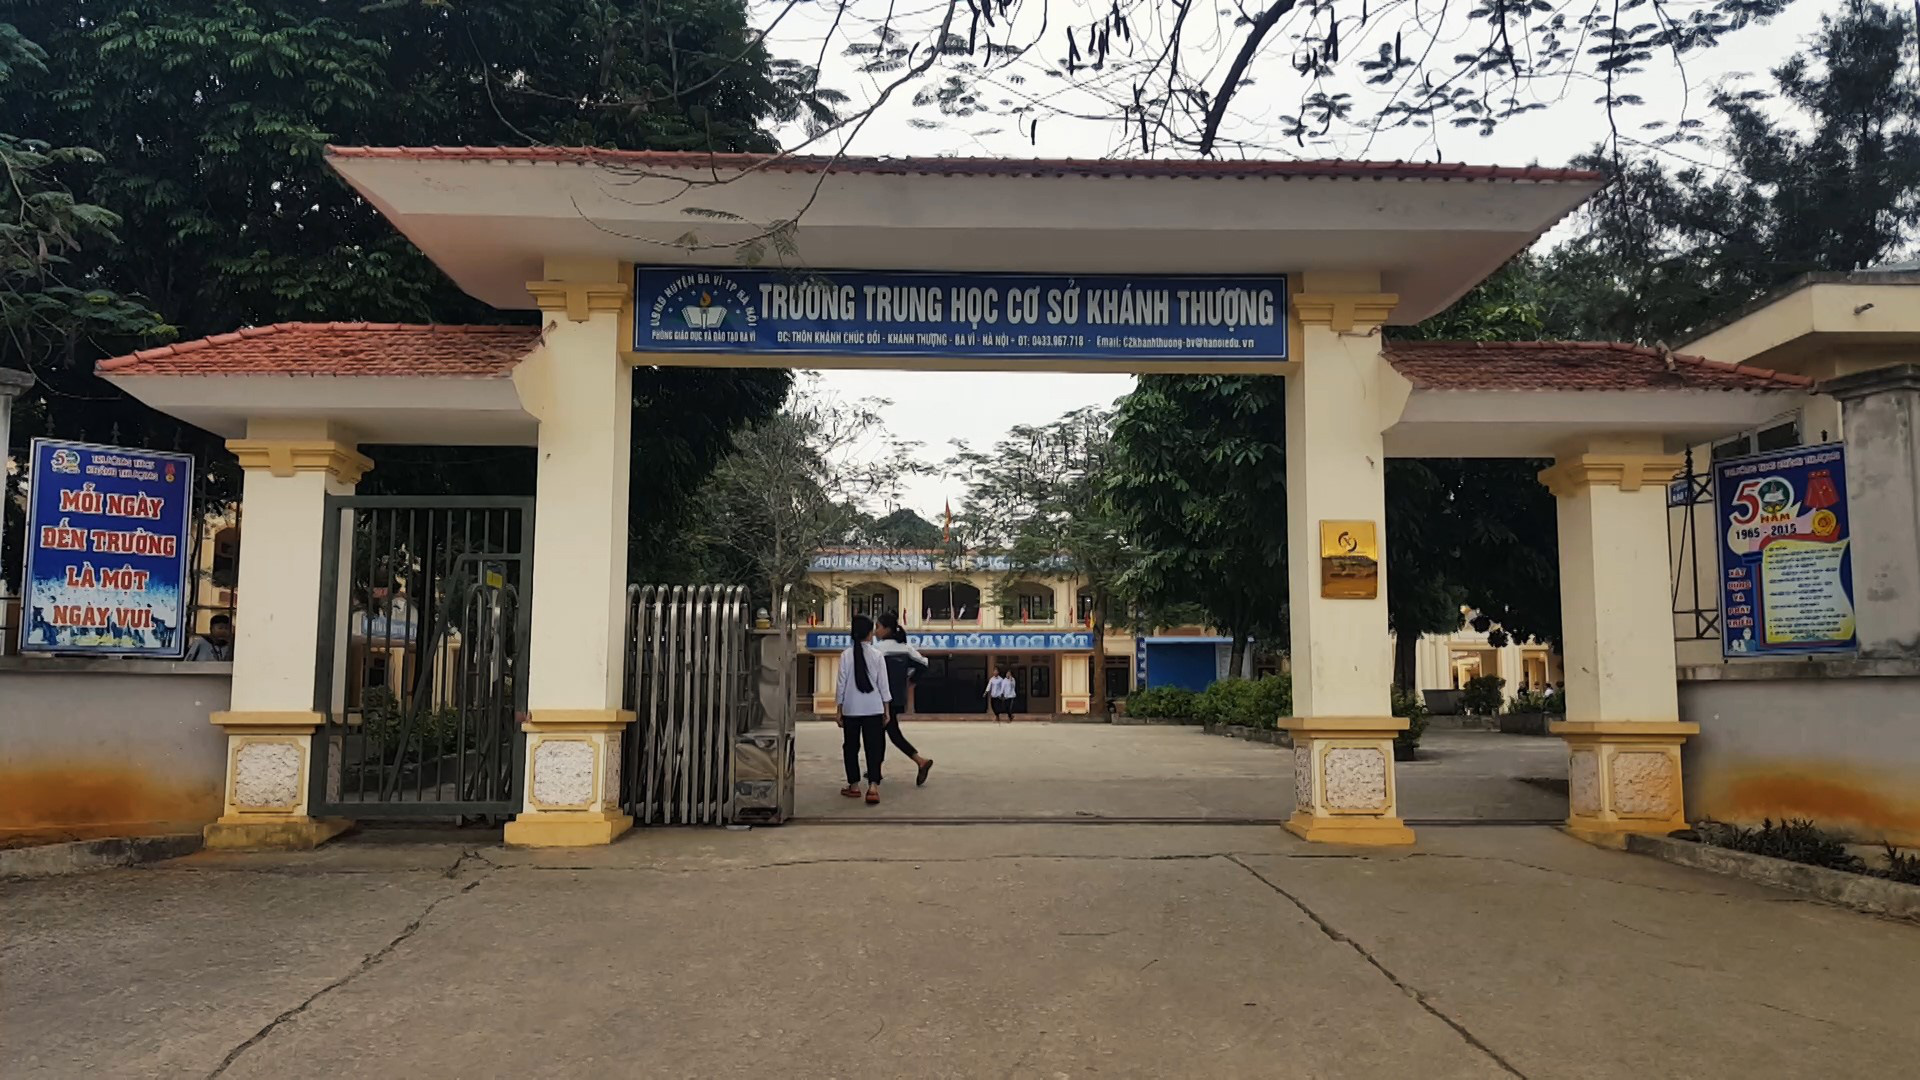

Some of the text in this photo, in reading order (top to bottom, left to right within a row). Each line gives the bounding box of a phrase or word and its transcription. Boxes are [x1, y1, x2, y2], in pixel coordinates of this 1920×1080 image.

[759, 278, 1274, 332] TRƯỜNG TRUNG HỌC CƠ SỞ KHÁNH THƯỢNG
[792, 330, 813, 343] THÔN
[814, 330, 841, 344] KHÁNH
[844, 330, 864, 344] CHÚC
[887, 331, 914, 344] KHÁNH
[916, 332, 947, 347] THƯỢNG
[954, 334, 965, 346] BA
[967, 332, 975, 346] VÌ
[982, 332, 993, 346] HÀ
[995, 332, 1009, 348] NỘI
[1096, 335, 1121, 348] Email:
[60, 483, 164, 519] MỖI NGÀY
[41, 518, 176, 557] ĐẾN TRƯỜNG
[1736, 527, 1760, 540] 1965
[1771, 523, 1797, 536] 2015
[66, 562, 149, 595] LÀ MỘT
[52, 602, 110, 627] NGÀY
[817, 635, 852, 647] THI
[1049, 632, 1088, 647] TỐT
